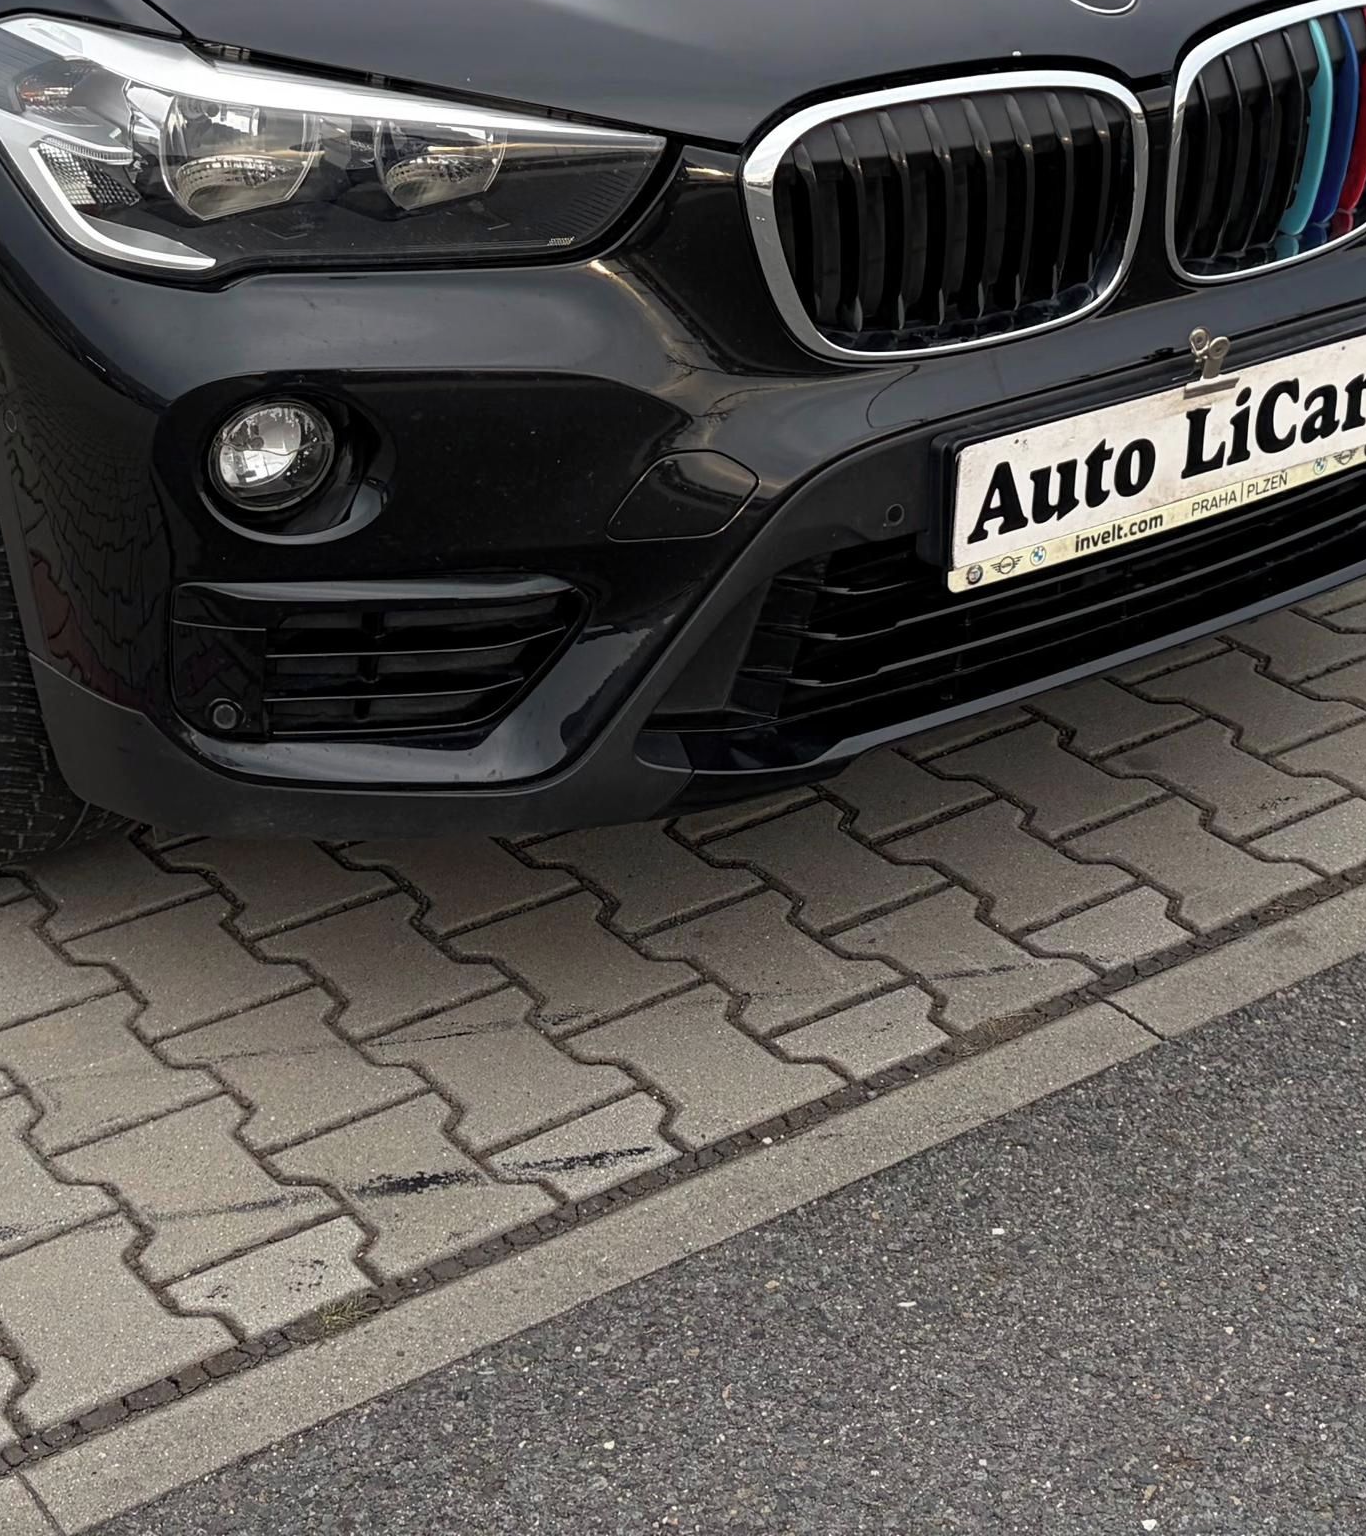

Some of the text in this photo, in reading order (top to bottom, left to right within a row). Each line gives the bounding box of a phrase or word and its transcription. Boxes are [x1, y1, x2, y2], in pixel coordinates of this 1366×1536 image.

[967, 437, 1156, 545] Auto
[1074, 469, 1289, 554] invelt.com PRAHA PLZEŇ
